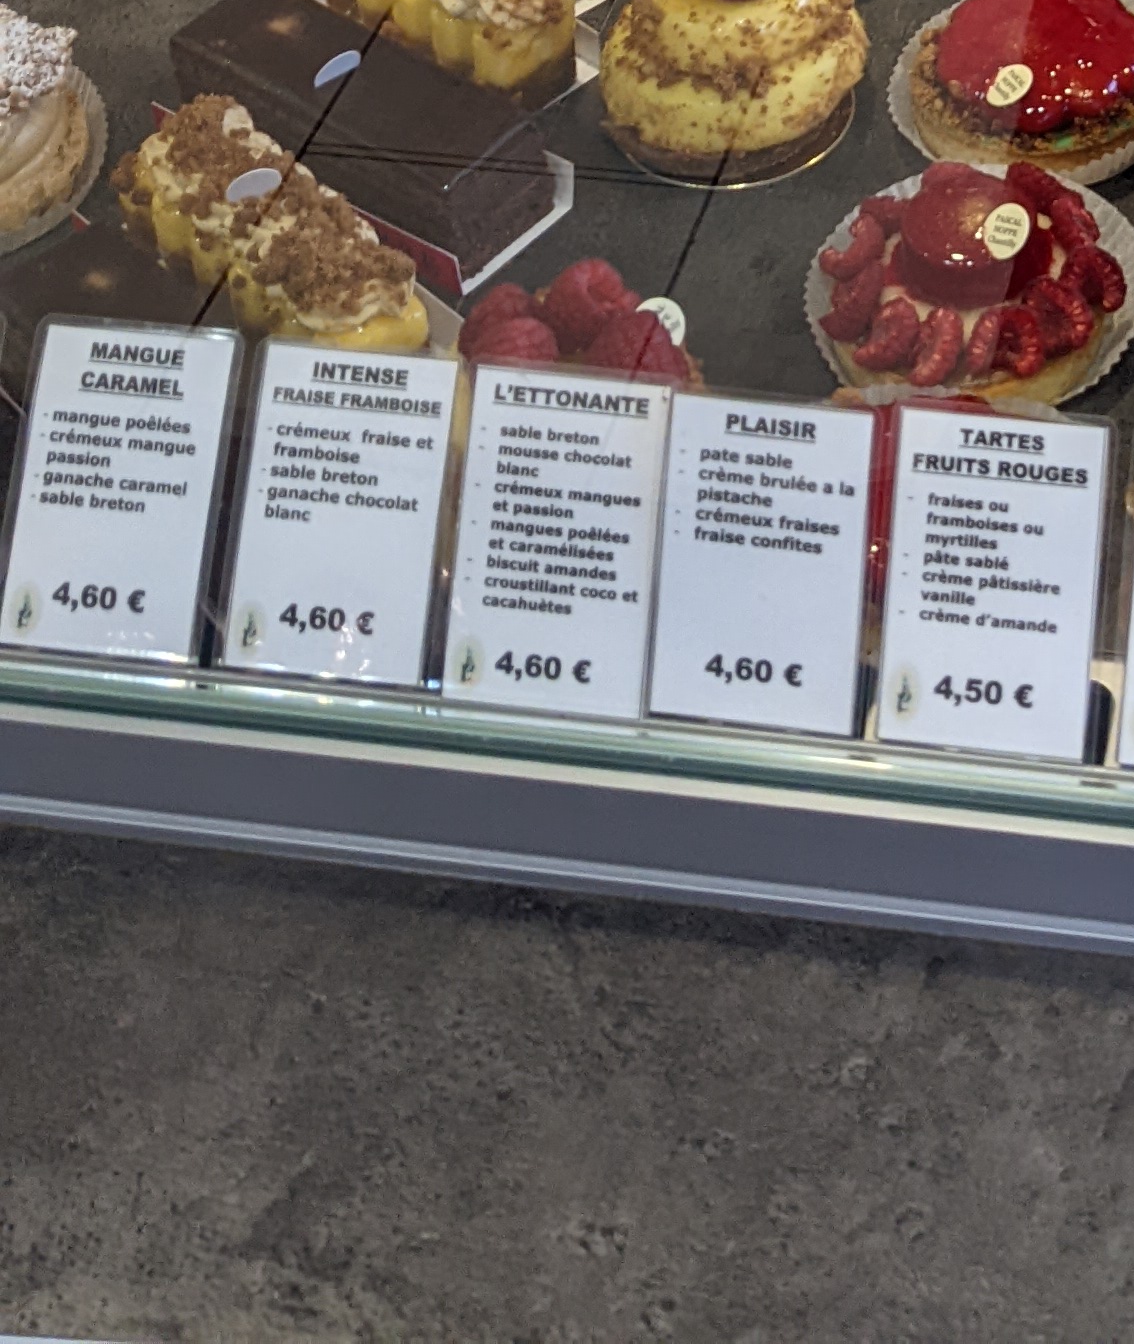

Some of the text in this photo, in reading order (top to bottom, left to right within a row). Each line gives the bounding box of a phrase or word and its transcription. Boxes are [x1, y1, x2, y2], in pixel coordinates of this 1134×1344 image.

[89, 341, 186, 367] MANGUE
[79, 370, 184, 397] CARAMEL
[311, 360, 409, 386] INTENSE
[272, 385, 442, 416] FRAISE FRAMBOISE
[493, 382, 650, 417] L'ETTONANTE
[51, 409, 191, 435] mangue poêlées
[724, 412, 817, 440] PLAISIR
[48, 430, 197, 456] crémeux mangue
[275, 423, 434, 451] crémeux fraise et
[545, 428, 600, 446] breton
[959, 427, 1045, 451] TARTES
[44, 450, 111, 468] passion
[272, 442, 361, 465] framboise
[497, 444, 632, 469] mousse chocolat
[698, 447, 741, 464] pate
[320, 467, 379, 487] breton
[495, 461, 540, 478] blanc
[912, 452, 1089, 485] FRUITS ROUGES
[42, 470, 188, 497] ganache caramel
[493, 481, 642, 508] crémeux mangues
[697, 467, 856, 497] crème brulée a la
[88, 493, 146, 513] breton
[266, 485, 419, 513] ganache chocolat
[491, 499, 574, 520] et passion
[695, 487, 773, 508] pistache
[927, 493, 1009, 514] fraises ou
[263, 504, 311, 523] blanc
[694, 507, 840, 537] crémeux fraises
[925, 511, 1044, 537] framboises ou
[489, 519, 630, 545] mangues poêlées
[693, 524, 823, 555] fraise confites
[923, 532, 998, 551] myrtilles
[487, 536, 615, 562] et caramélisées
[922, 550, 1010, 571] pâte sablé
[485, 553, 617, 582] biscuit amandes
[483, 575, 639, 603] croustillant coco et
[921, 570, 1061, 596] crème pâtissière
[51, 581, 146, 614] 4,60 €
[481, 594, 572, 616] cacahuètes
[920, 589, 976, 607] vanille
[278, 602, 375, 636] 4,60 €
[917, 608, 1058, 634] crème d'amande
[493, 650, 592, 685] 4,60 €
[703, 653, 803, 688] 4,60 €
[932, 674, 1034, 709] 4,50 €
